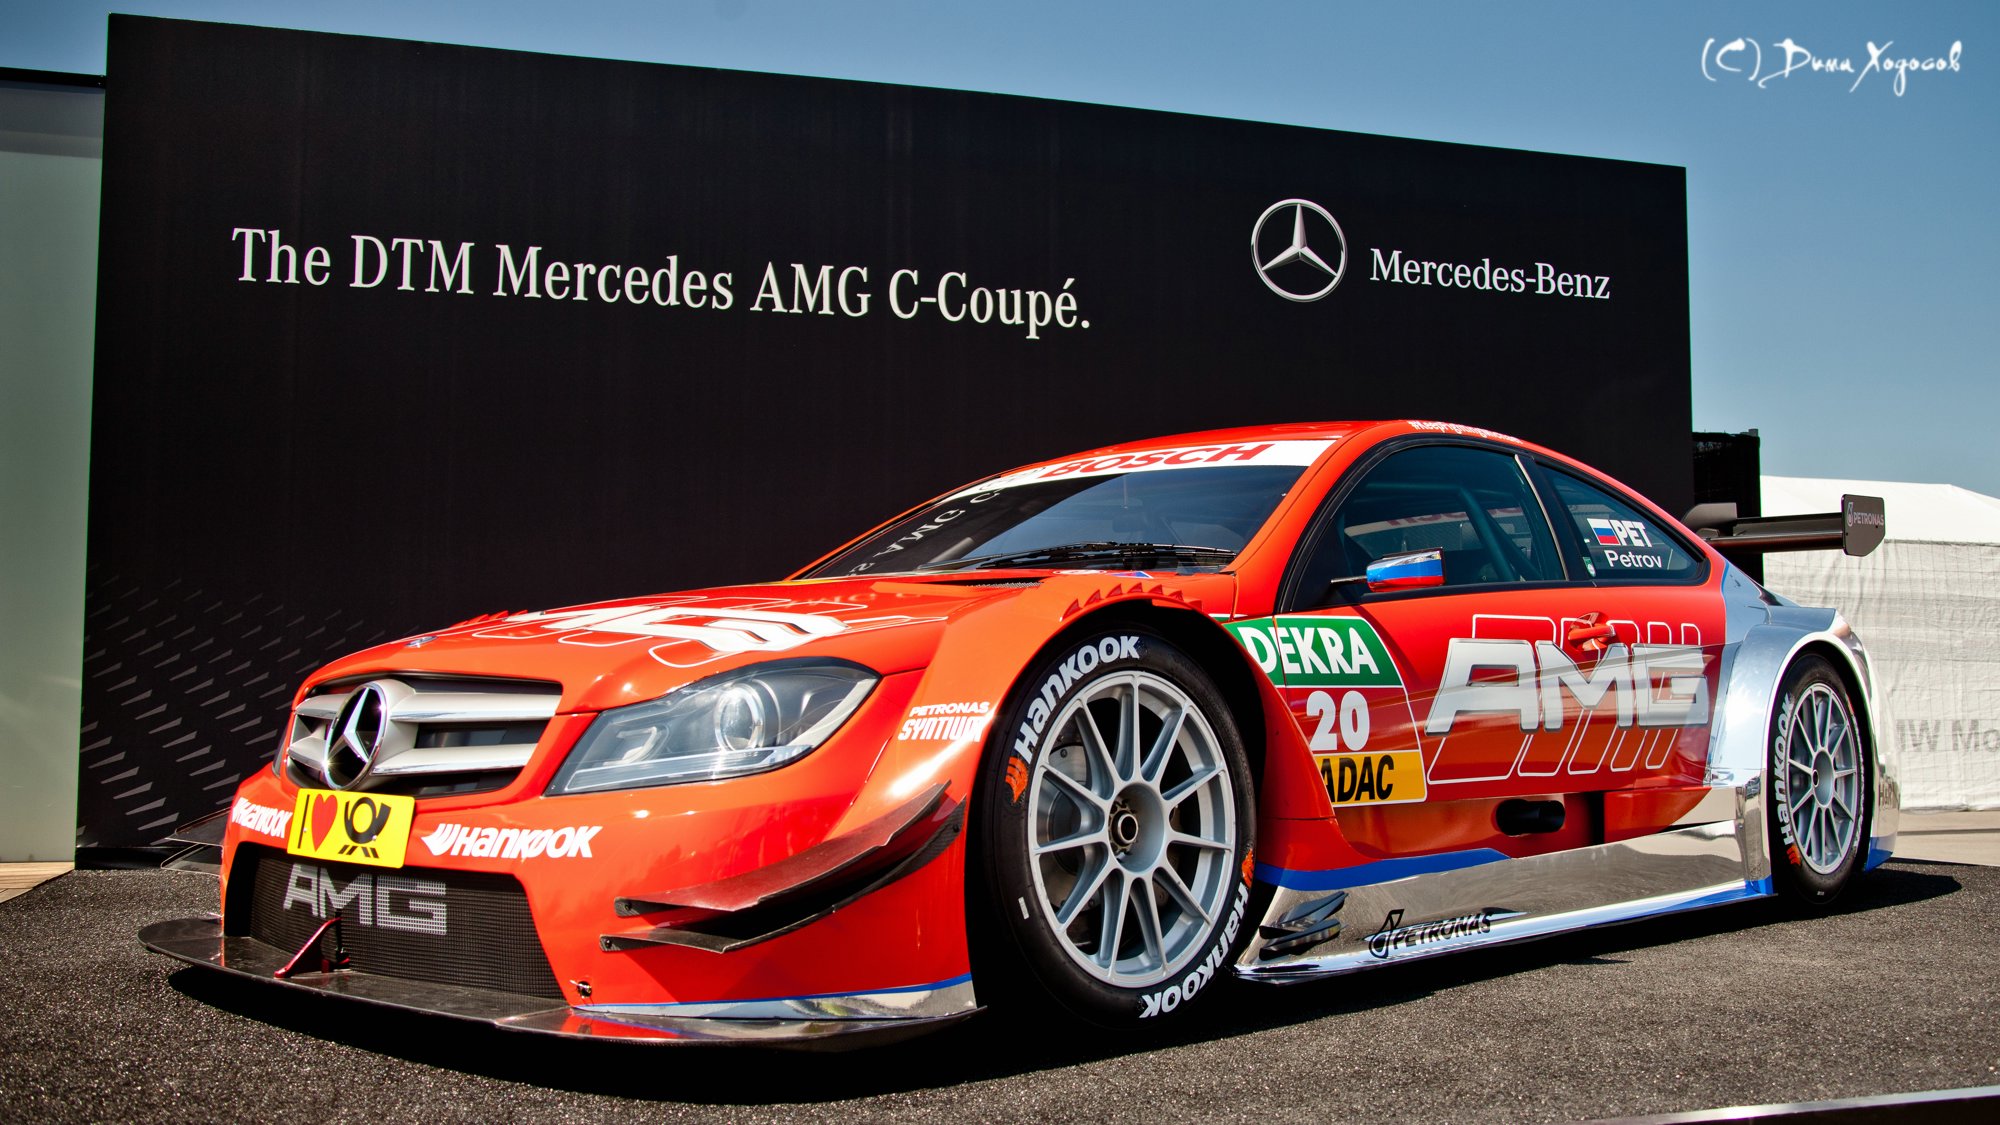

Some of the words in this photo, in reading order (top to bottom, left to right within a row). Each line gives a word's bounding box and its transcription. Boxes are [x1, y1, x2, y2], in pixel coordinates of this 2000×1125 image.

[232, 227, 331, 286] The
[350, 234, 475, 295] DTM
[493, 244, 733, 310] Mercedes
[750, 261, 871, 317] AMG
[889, 268, 1090, 339] C-Coupé.
[1370, 248, 1610, 299] Mercedes-Benz
[1036, 444, 1275, 479] BOSCH
[1609, 519, 1653, 548] PET
[1853, 511, 1884, 526] PETRONAS
[1603, 549, 1662, 568] Petrov
[1237, 626, 1380, 675] DEKRA
[909, 701, 990, 718] PETRONAS
[1423, 637, 1710, 737] AMG
[1306, 690, 1370, 751] 20
[1320, 754, 1395, 803] ADAC
[283, 862, 447, 936] AMG
[1392, 912, 1493, 950] PETRONAS
